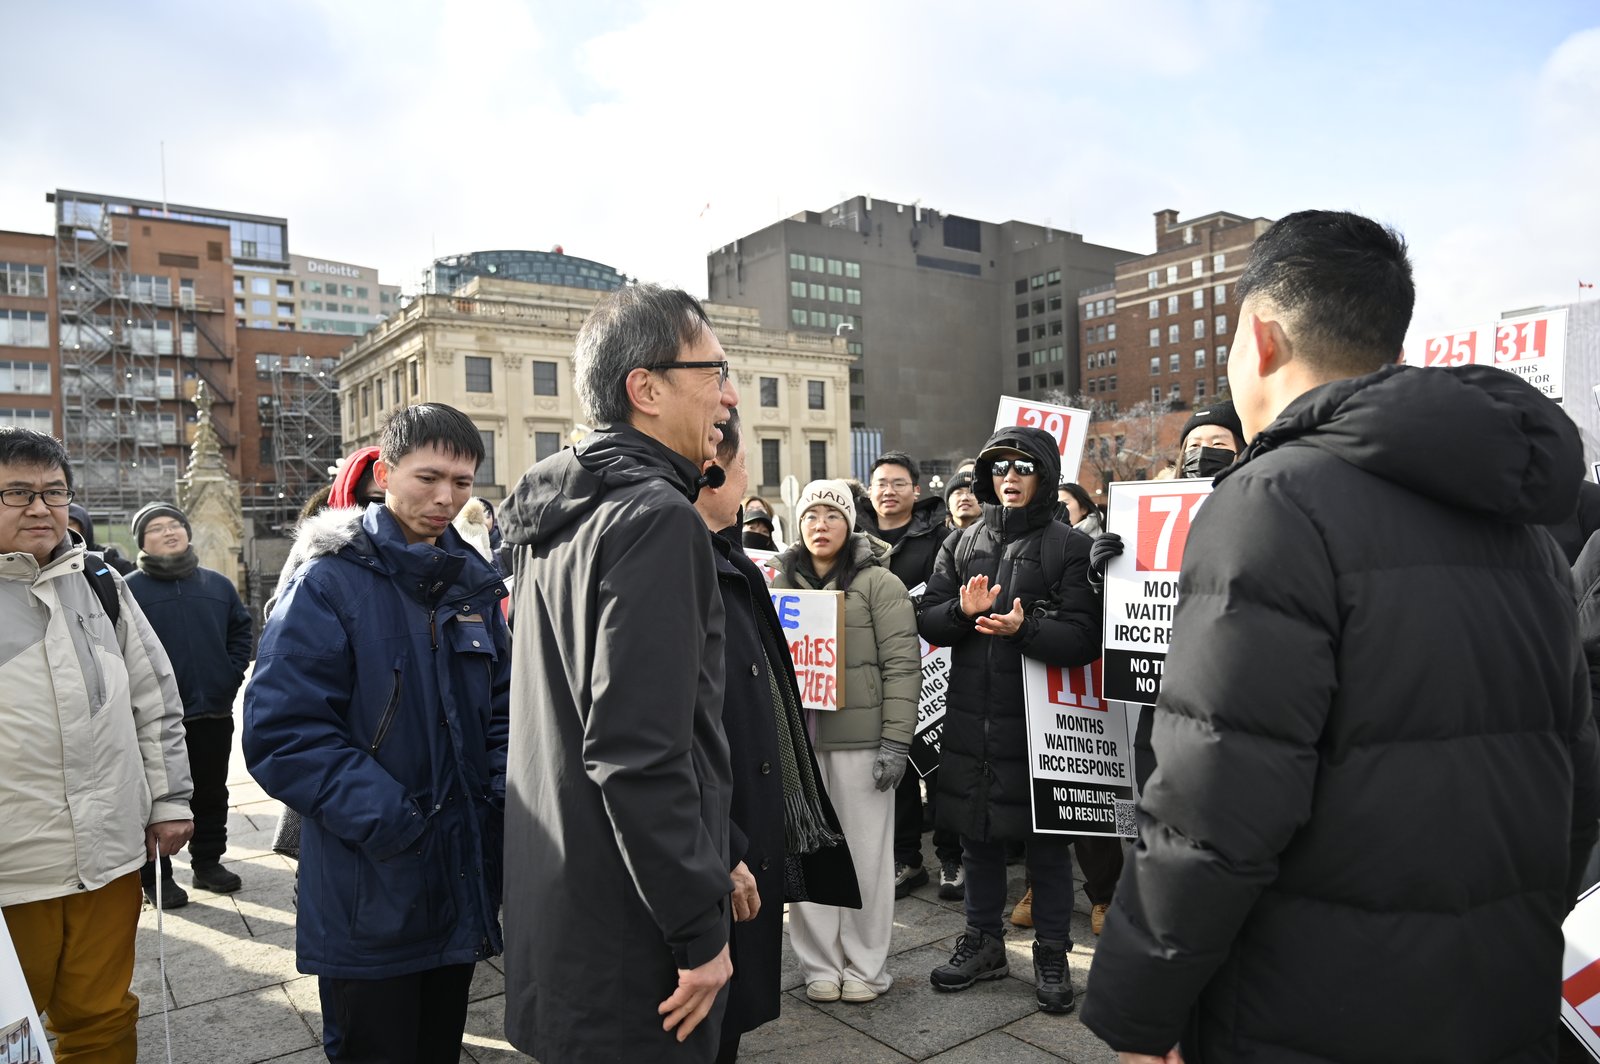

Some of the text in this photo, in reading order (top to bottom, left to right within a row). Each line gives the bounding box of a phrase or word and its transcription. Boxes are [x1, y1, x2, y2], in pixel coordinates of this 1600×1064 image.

[308, 260, 360, 279] Deloitte
[1429, 332, 1471, 367] 25
[1495, 321, 1539, 362] 31
[1114, 624, 1151, 643] IRCC
[1130, 658, 1150, 674] NO
[1057, 664, 1100, 709] 11
[1136, 677, 1156, 693] NO
[1056, 713, 1104, 735] MONTHS
[922, 730, 938, 746] NO
[1044, 733, 1118, 757] WAITING FOR
[1039, 754, 1126, 778] IRCC RESPONSE
[1053, 787, 1116, 805] NO TIMELINES
[1058, 805, 1115, 823] NO RESULTS
